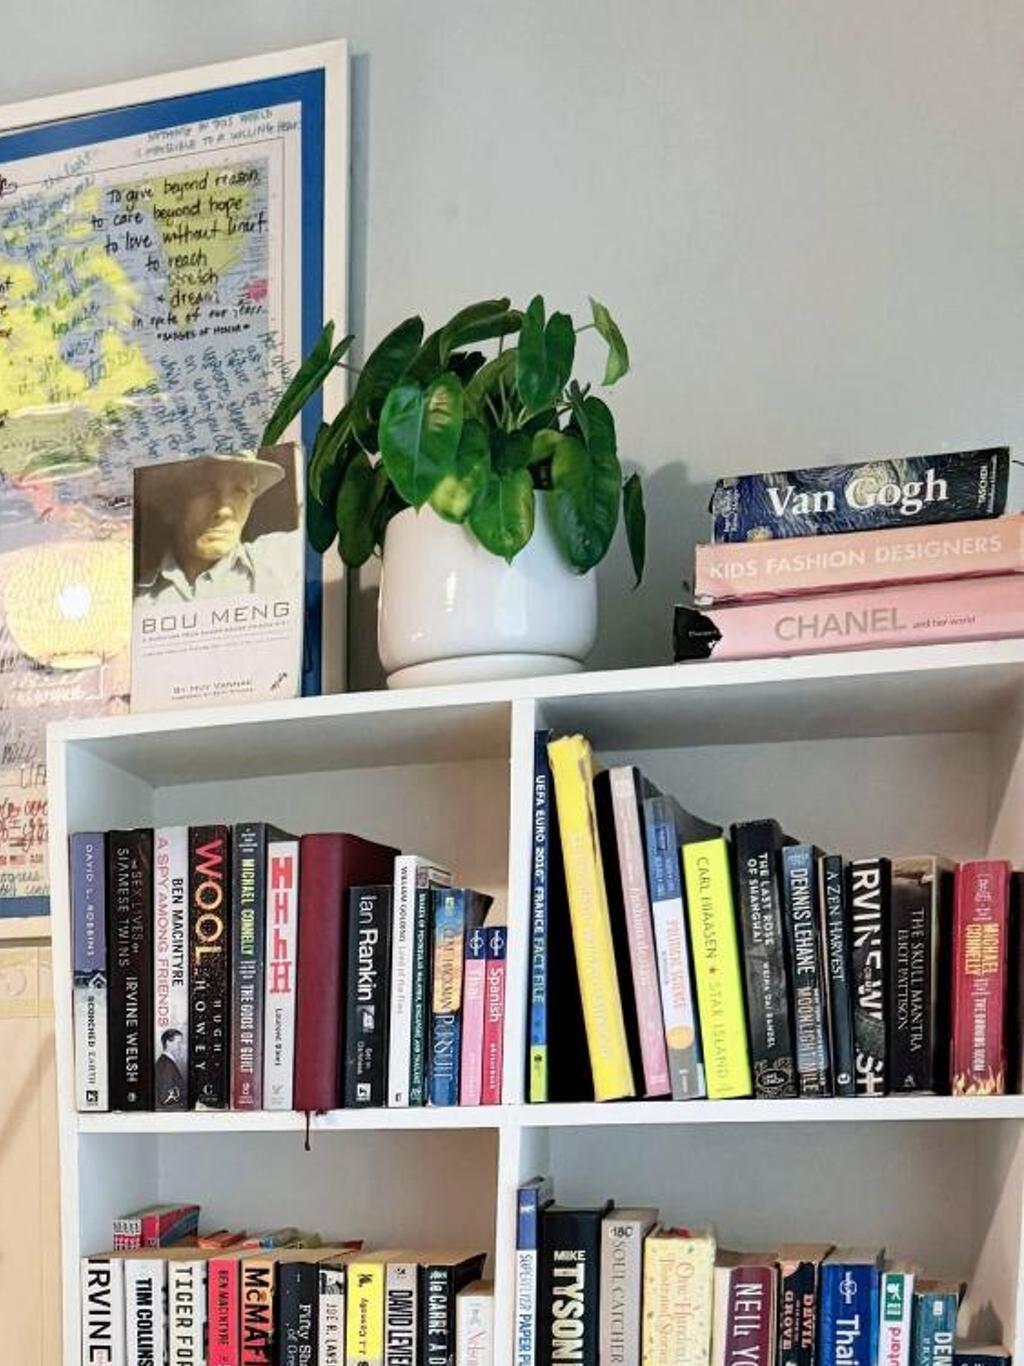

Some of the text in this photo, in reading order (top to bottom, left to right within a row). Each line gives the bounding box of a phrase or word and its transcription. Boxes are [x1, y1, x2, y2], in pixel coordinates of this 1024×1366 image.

[92, 197, 242, 229] to care beyond hope
[126, 187, 155, 212] give
[164, 173, 210, 195] beyond
[106, 238, 119, 254] to
[126, 232, 152, 250] love
[163, 224, 224, 244] without
[146, 251, 208, 272] to reach
[766, 469, 949, 517] Van Gogh
[710, 535, 1002, 579] KIDS FASHION DESIGNERS
[142, 602, 290, 634] BOU MENG
[775, 607, 907, 641] CHANEL
[85, 844, 94, 881] DAVID
[534, 775, 545, 1002] UEFA EURO FRANCE FACT FILE
[117, 848, 129, 967] SIAMESE TWINS
[194, 839, 223, 968] WOOL
[241, 858, 254, 956] MICHAEL CONNELLY
[696, 856, 717, 959] CARL HIAASEN
[748, 859, 762, 943] OF SHANGHAI
[758, 852, 774, 945] THE LAST ROSE
[789, 868, 815, 975] DENNIS LEHANE
[86, 904, 94, 956] ROBBINS
[157, 838, 169, 1027] A SPY AMONG FRIENDS
[171, 878, 184, 987] BEN MACINTYRE
[358, 895, 377, 1000] Ian Rankin
[827, 871, 844, 981] A ZEN HARVEST
[965, 923, 982, 975] CONNELLY
[981, 922, 998, 973] MICHAEL
[490, 968, 502, 1023] Spanish
[898, 968, 908, 1030] PATTISON
[910, 908, 924, 1052] THE SKULL MANTRA
[125, 977, 138, 1082] IRVINE WELSH
[241, 984, 254, 1073] THE GODS OF GUILT
[434, 1015, 454, 1080] PURSUIT
[712, 1023, 728, 1079] ISLAND
[801, 1062, 819, 1092] MILE
[554, 1250, 585, 1260] MIKE
[88, 1260, 112, 1362] IRVINE
[137, 1278, 152, 1306] TIM
[175, 1267, 193, 1328] TIGER
[326, 1303, 336, 1321] JOE
[389, 1290, 413, 1326] DAVID
[430, 1281, 447, 1292] le
[552, 1263, 585, 1359] TYSON
[610, 1241, 626, 1363] SOUL CATCHER
[733, 1283, 762, 1336] NEIL
[288, 1329, 296, 1340] of
[298, 1304, 311, 1339] Fifty
[326, 1325, 336, 1336] R.
[430, 1343, 447, 1352] A
[520, 1313, 531, 1351] PAPER
[802, 1294, 813, 1349] DEVIL
